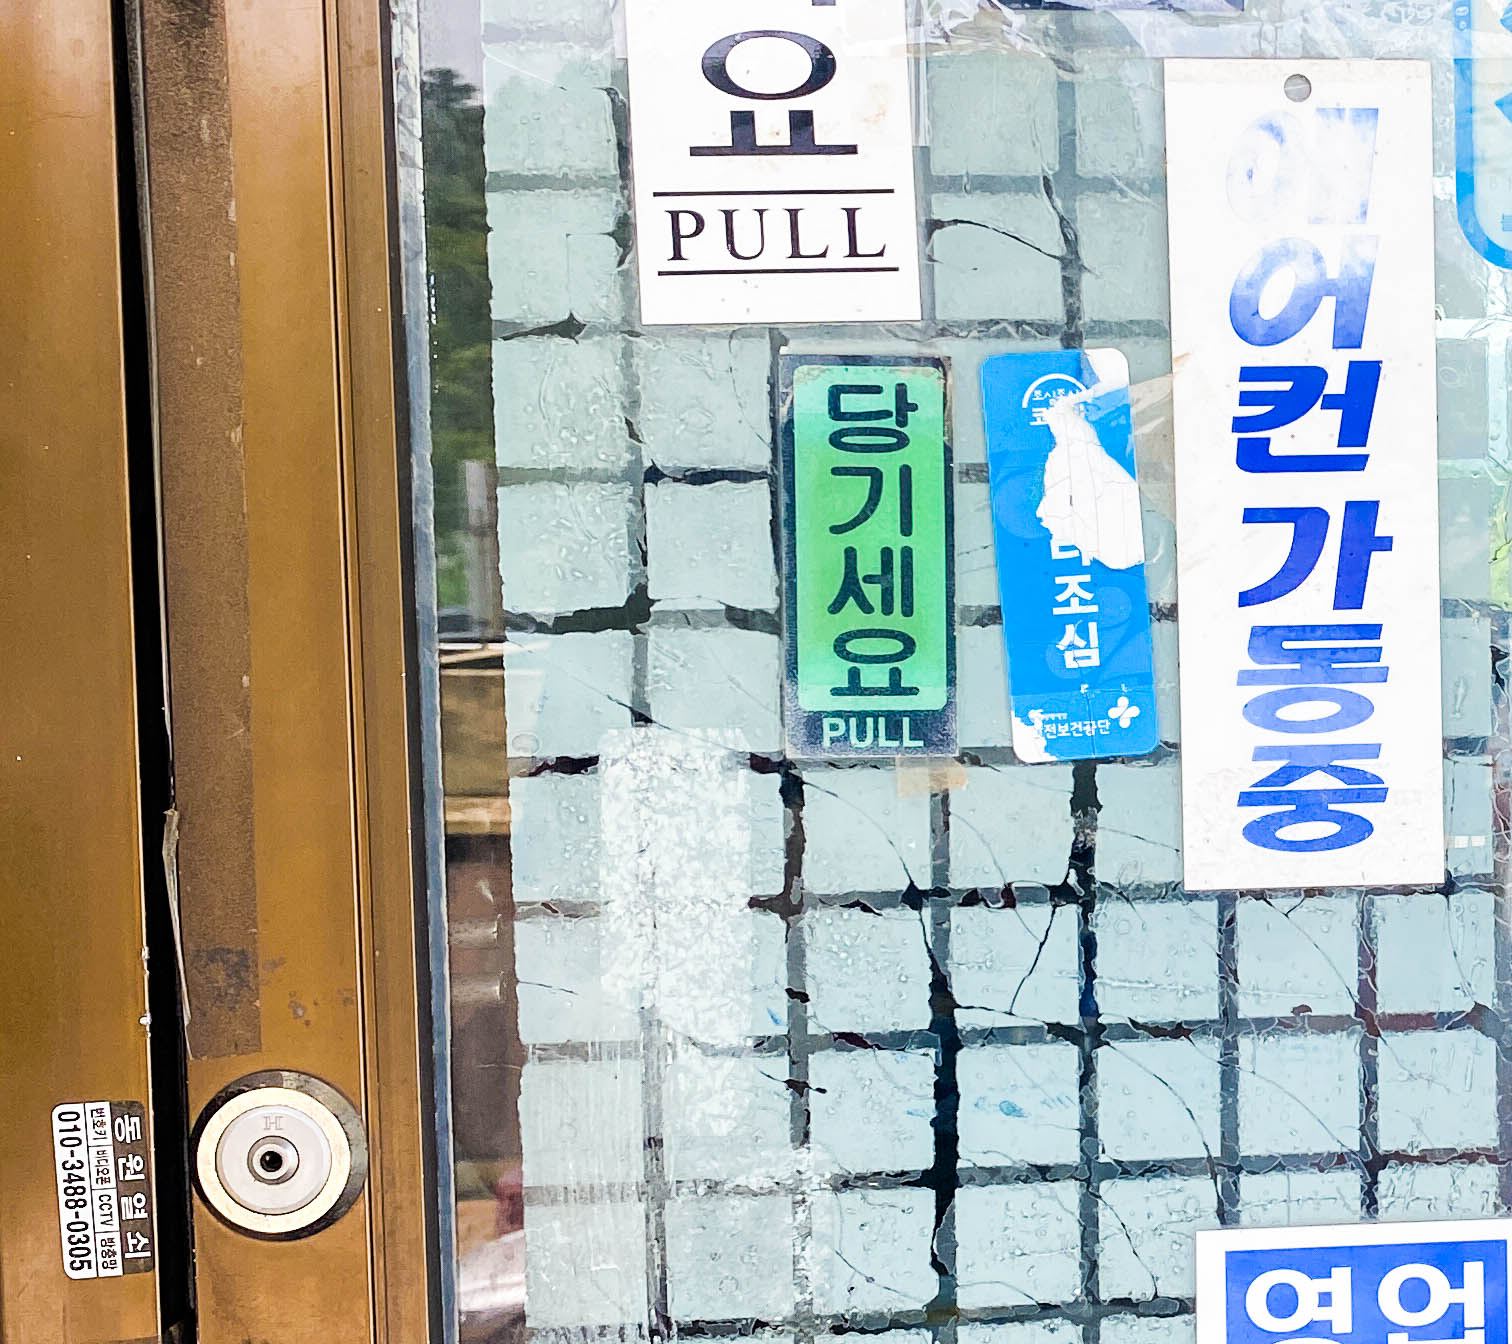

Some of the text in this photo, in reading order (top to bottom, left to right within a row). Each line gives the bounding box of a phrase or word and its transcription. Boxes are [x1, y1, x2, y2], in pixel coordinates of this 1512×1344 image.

[664, 207, 888, 262] PULL
[827, 382, 920, 698] 당기세요
[822, 716, 925, 749] PULL
[57, 1110, 93, 1272] 010-3488-0305
[97, 1193, 115, 1227] CCTV
[114, 1114, 151, 1259] 동원열쇠
[100, 1236, 119, 1271] 방충망
